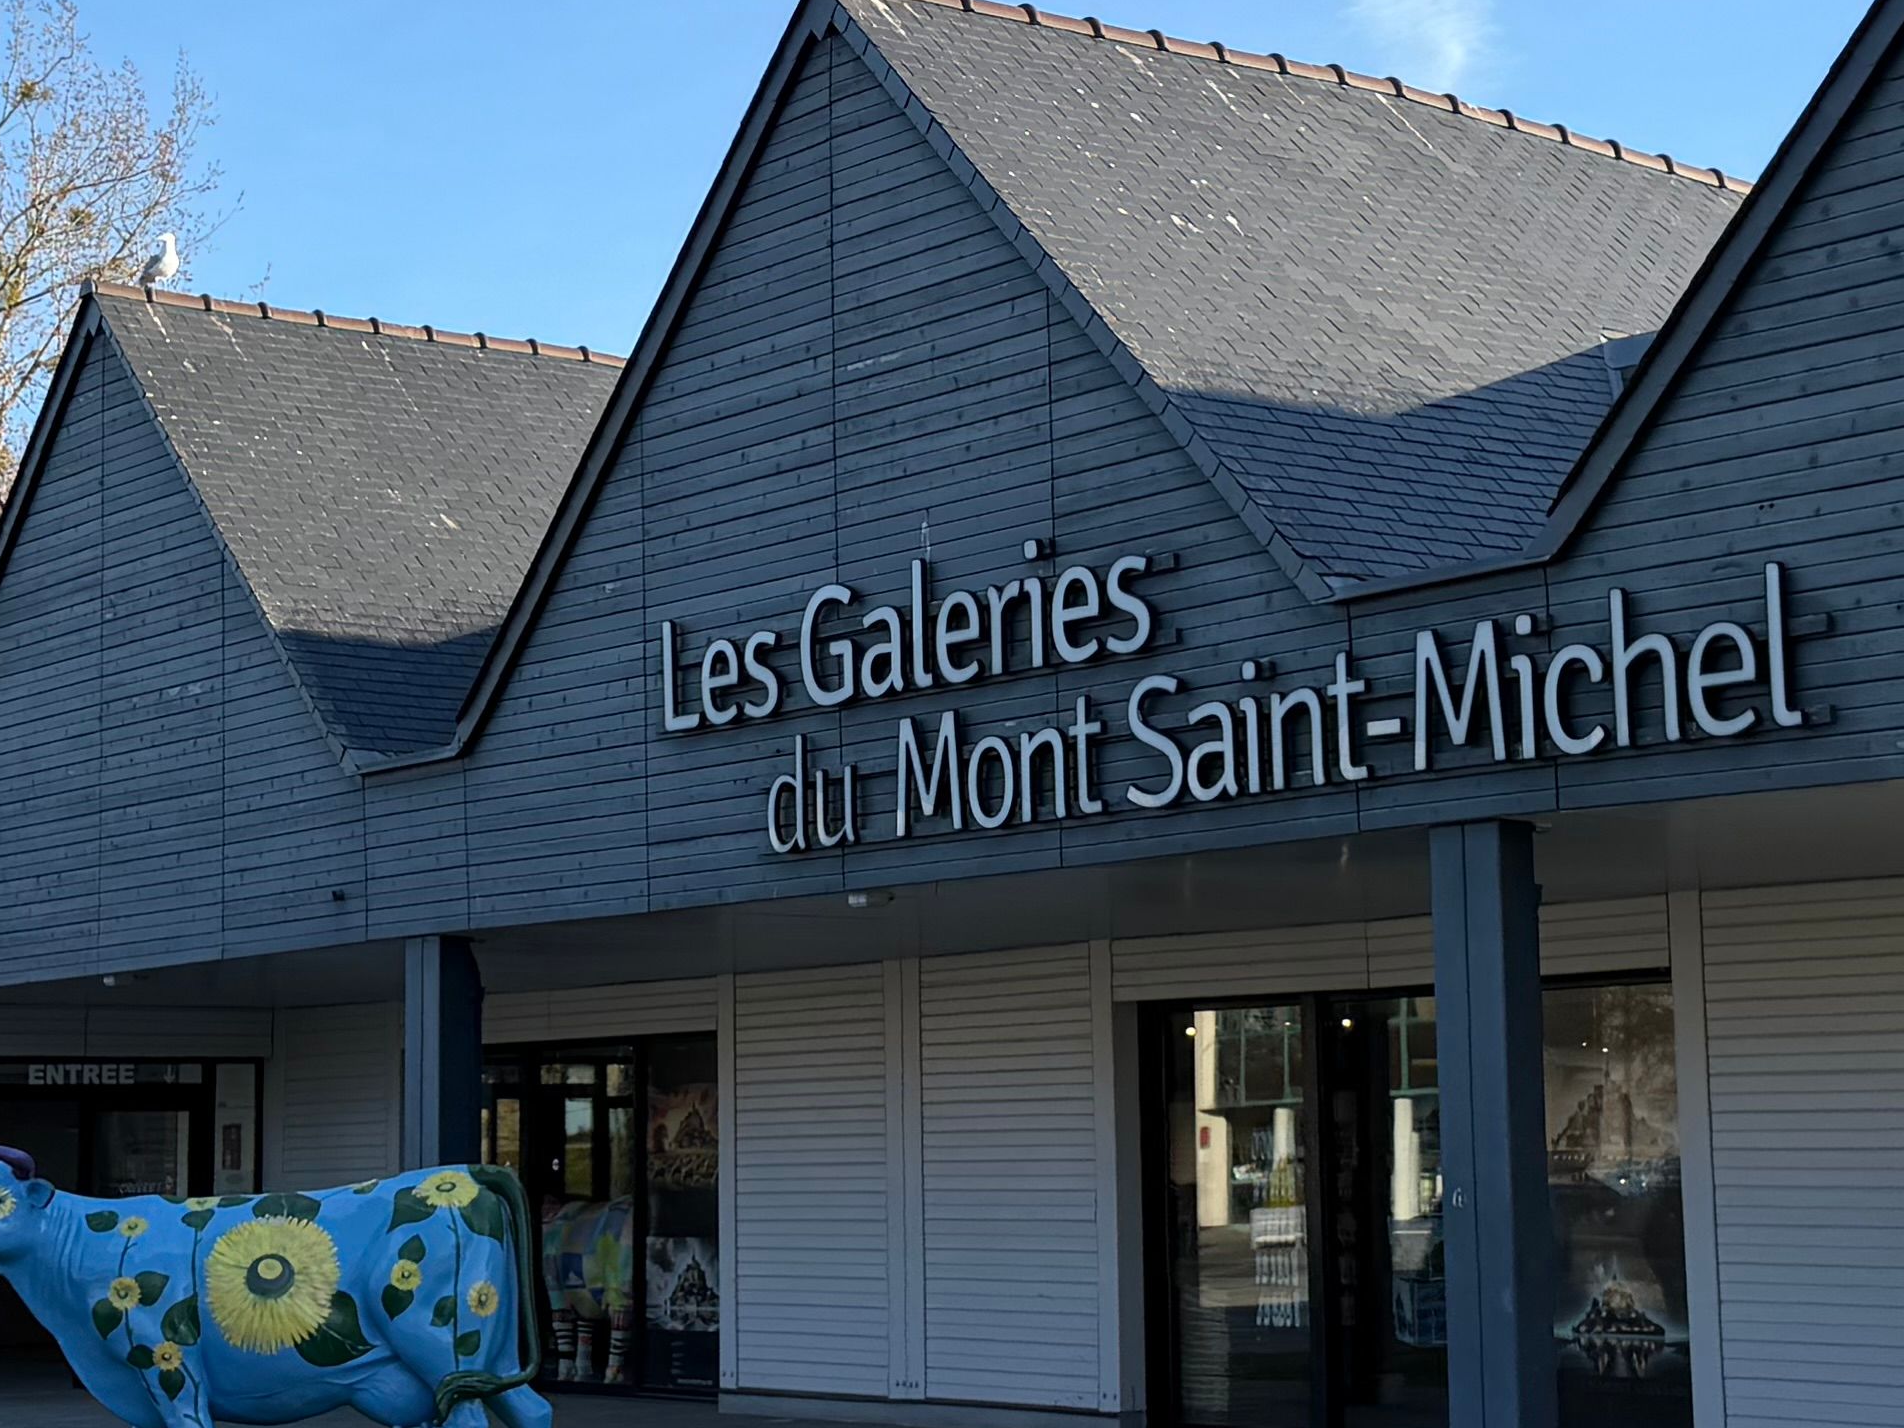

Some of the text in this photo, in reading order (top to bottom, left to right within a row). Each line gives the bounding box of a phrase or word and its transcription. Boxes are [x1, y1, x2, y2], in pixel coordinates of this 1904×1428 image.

[660, 538, 1154, 733] Les Galeries
[767, 560, 1804, 855] du Mont Saint-Michel
[28, 1063, 136, 1085] ENTREE
